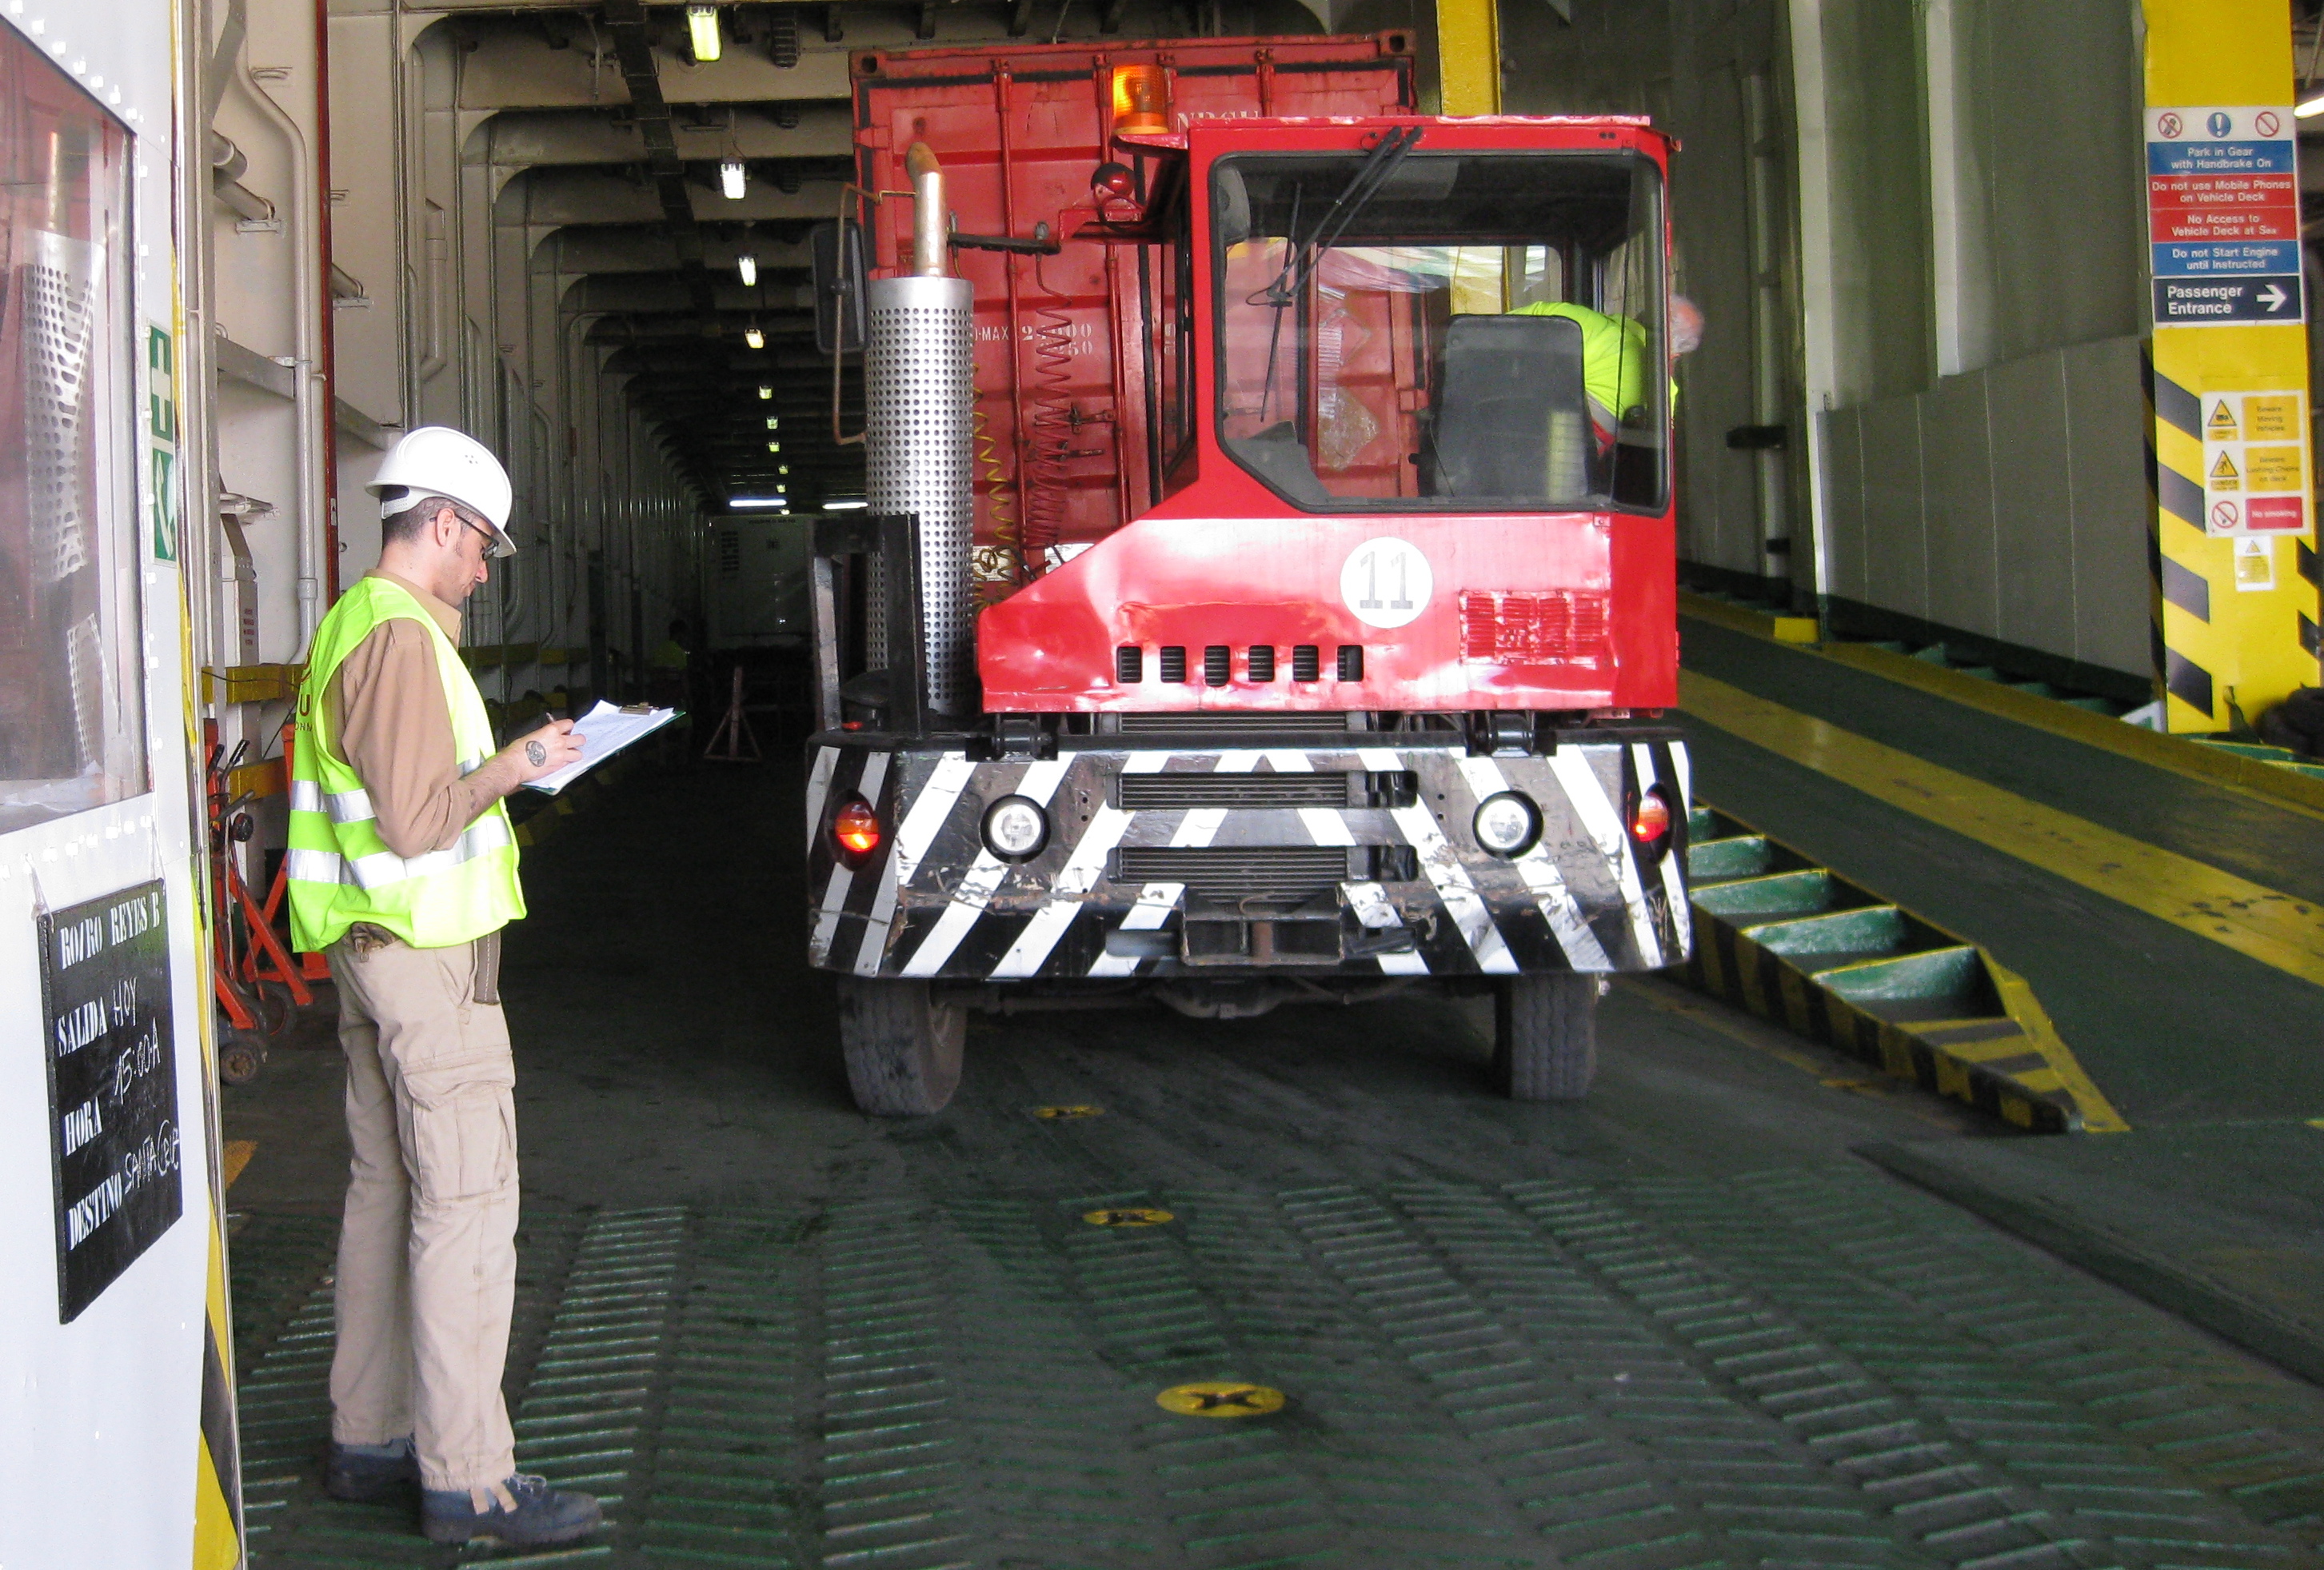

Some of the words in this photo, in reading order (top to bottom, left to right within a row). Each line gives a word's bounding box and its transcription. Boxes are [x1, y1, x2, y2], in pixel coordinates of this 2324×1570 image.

[2187, 147, 2210, 157] Park
[2214, 147, 2223, 156] in
[2227, 146, 2254, 156] Gear
[2170, 159, 2193, 170] with
[2197, 159, 2253, 169] Handbrake
[2257, 158, 2271, 167] On
[2152, 182, 2166, 191] Do
[2170, 182, 2188, 191] not
[2192, 182, 2211, 191] use
[2215, 180, 2250, 190] Mobile
[2253, 179, 2292, 190] Phones
[2180, 194, 2193, 203] on
[2197, 193, 2234, 202] Vehicle
[2238, 192, 2265, 202] Deck
[2187, 215, 2202, 224] No
[2206, 214, 2245, 225] Access
[2249, 214, 2260, 223] to
[2171, 226, 2209, 237] Vehicle
[2213, 226, 2240, 236] Deck
[2244, 226, 2254, 235] at
[2259, 225, 2277, 235] Sea
[2172, 248, 2187, 258] Do
[2191, 249, 2209, 258] not
[2213, 247, 2240, 258] Start
[2243, 247, 2278, 258] Engine
[2186, 260, 2209, 270] until
[2212, 259, 2266, 270] Instructed
[2167, 286, 2243, 301] Passenger
[2168, 302, 2233, 315] Entrance
[1360, 551, 1413, 609] 11
[110, 897, 148, 946] REYES
[113, 977, 137, 1027] HOY
[58, 996, 108, 1057] SALIDA
[65, 1096, 103, 1157] HORA
[124, 1134, 158, 1195] SANTA
[69, 1172, 123, 1251] DESTINO
